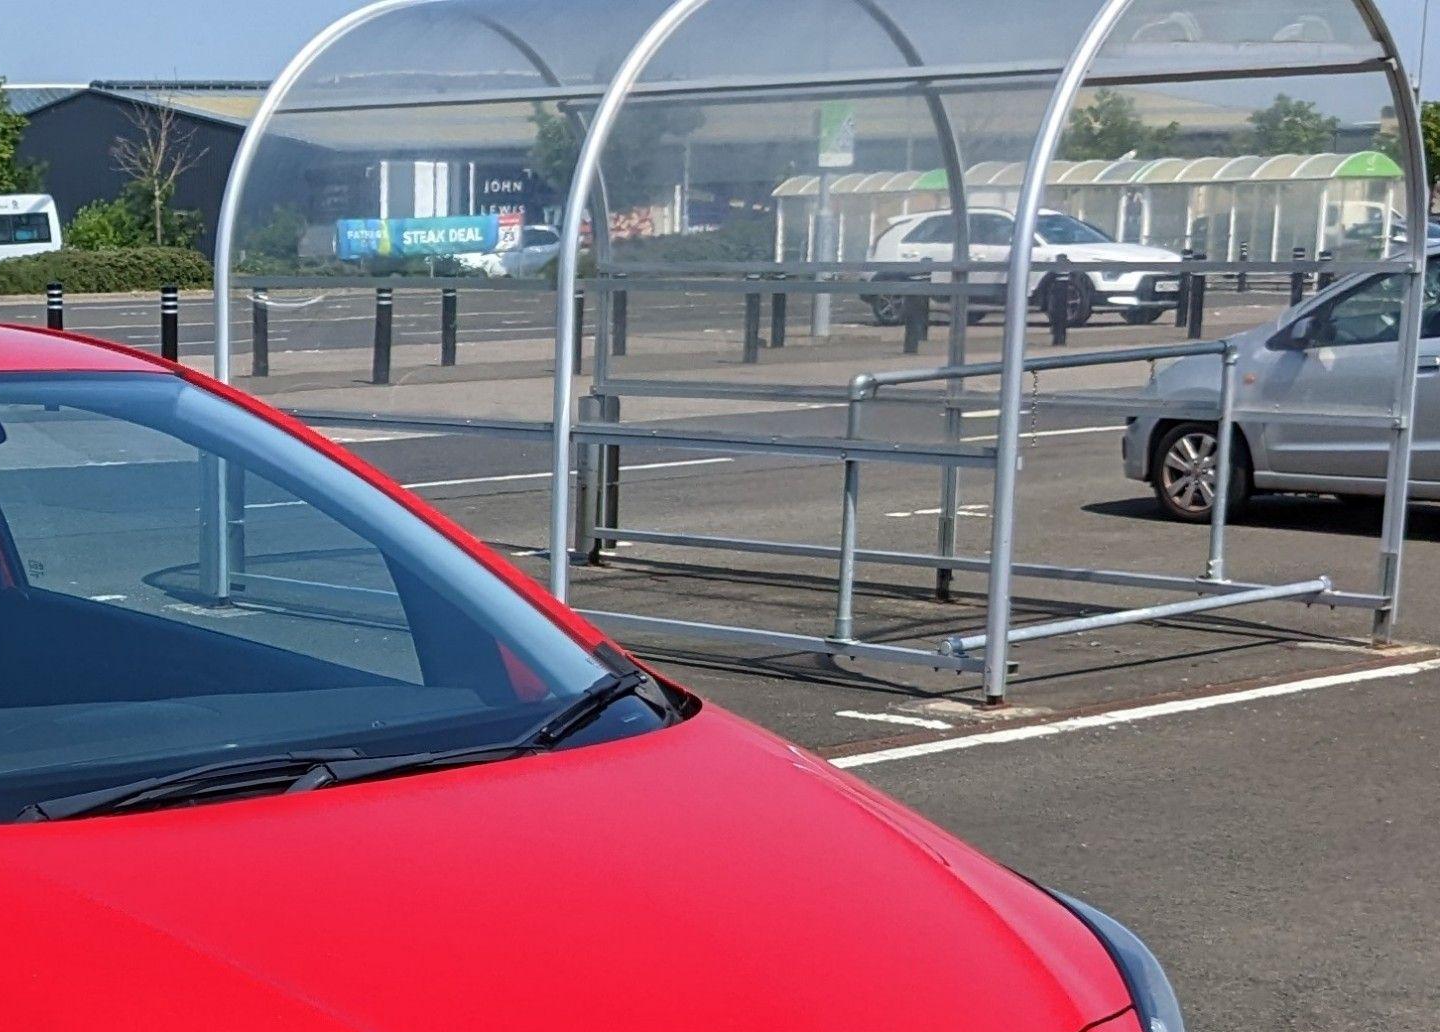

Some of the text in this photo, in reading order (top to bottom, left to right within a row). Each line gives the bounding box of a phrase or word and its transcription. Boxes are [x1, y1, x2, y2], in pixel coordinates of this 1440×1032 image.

[483, 180, 523, 193] JOHN
[480, 204, 526, 215] LEWIS
[402, 227, 483, 245] STEAK DEAL
